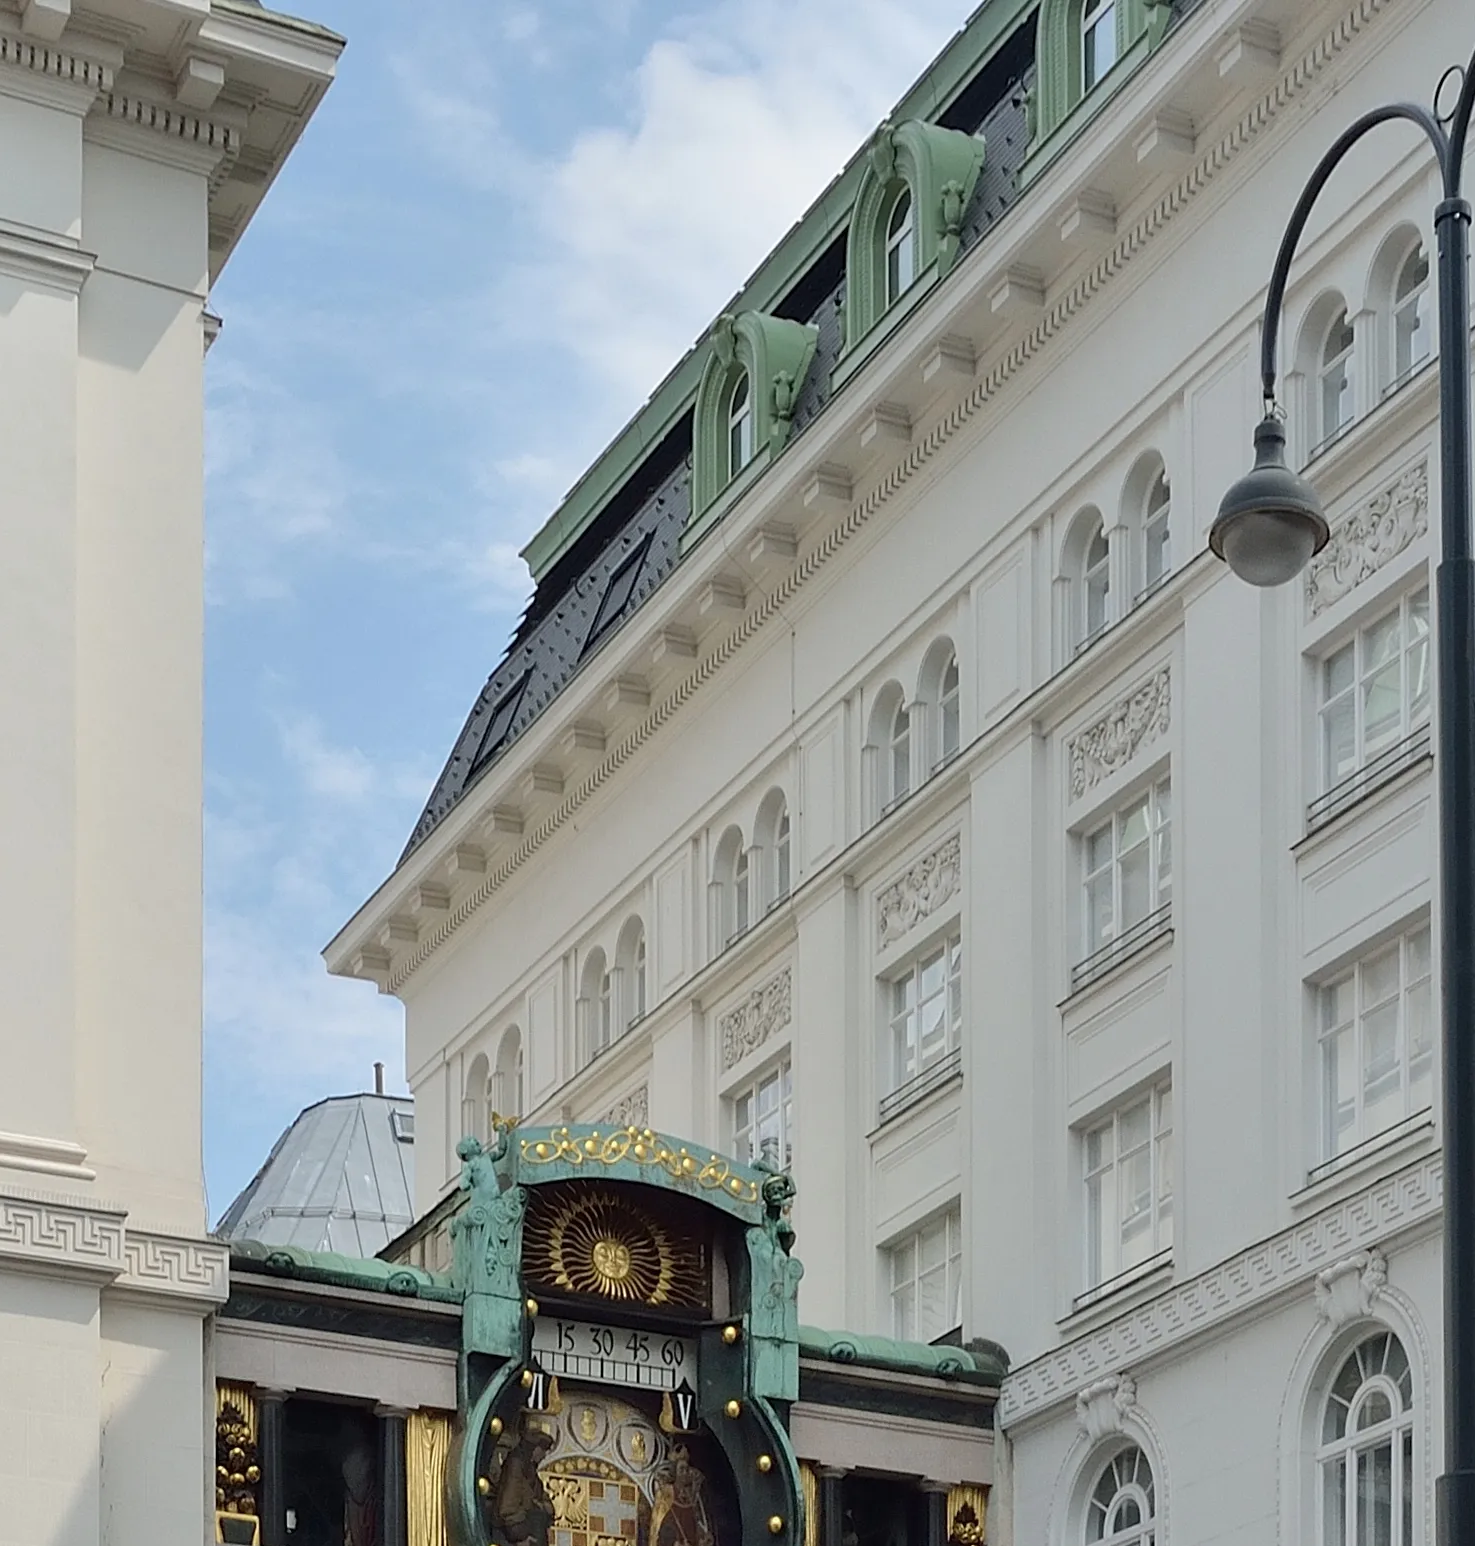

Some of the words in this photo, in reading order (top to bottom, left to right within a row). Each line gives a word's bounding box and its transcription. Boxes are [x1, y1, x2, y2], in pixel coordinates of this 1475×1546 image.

[557, 1322, 575, 1351] 15
[590, 1327, 614, 1356] 30
[626, 1332, 650, 1362] 45
[662, 1339, 684, 1366] 60
[677, 1393, 692, 1429] V
